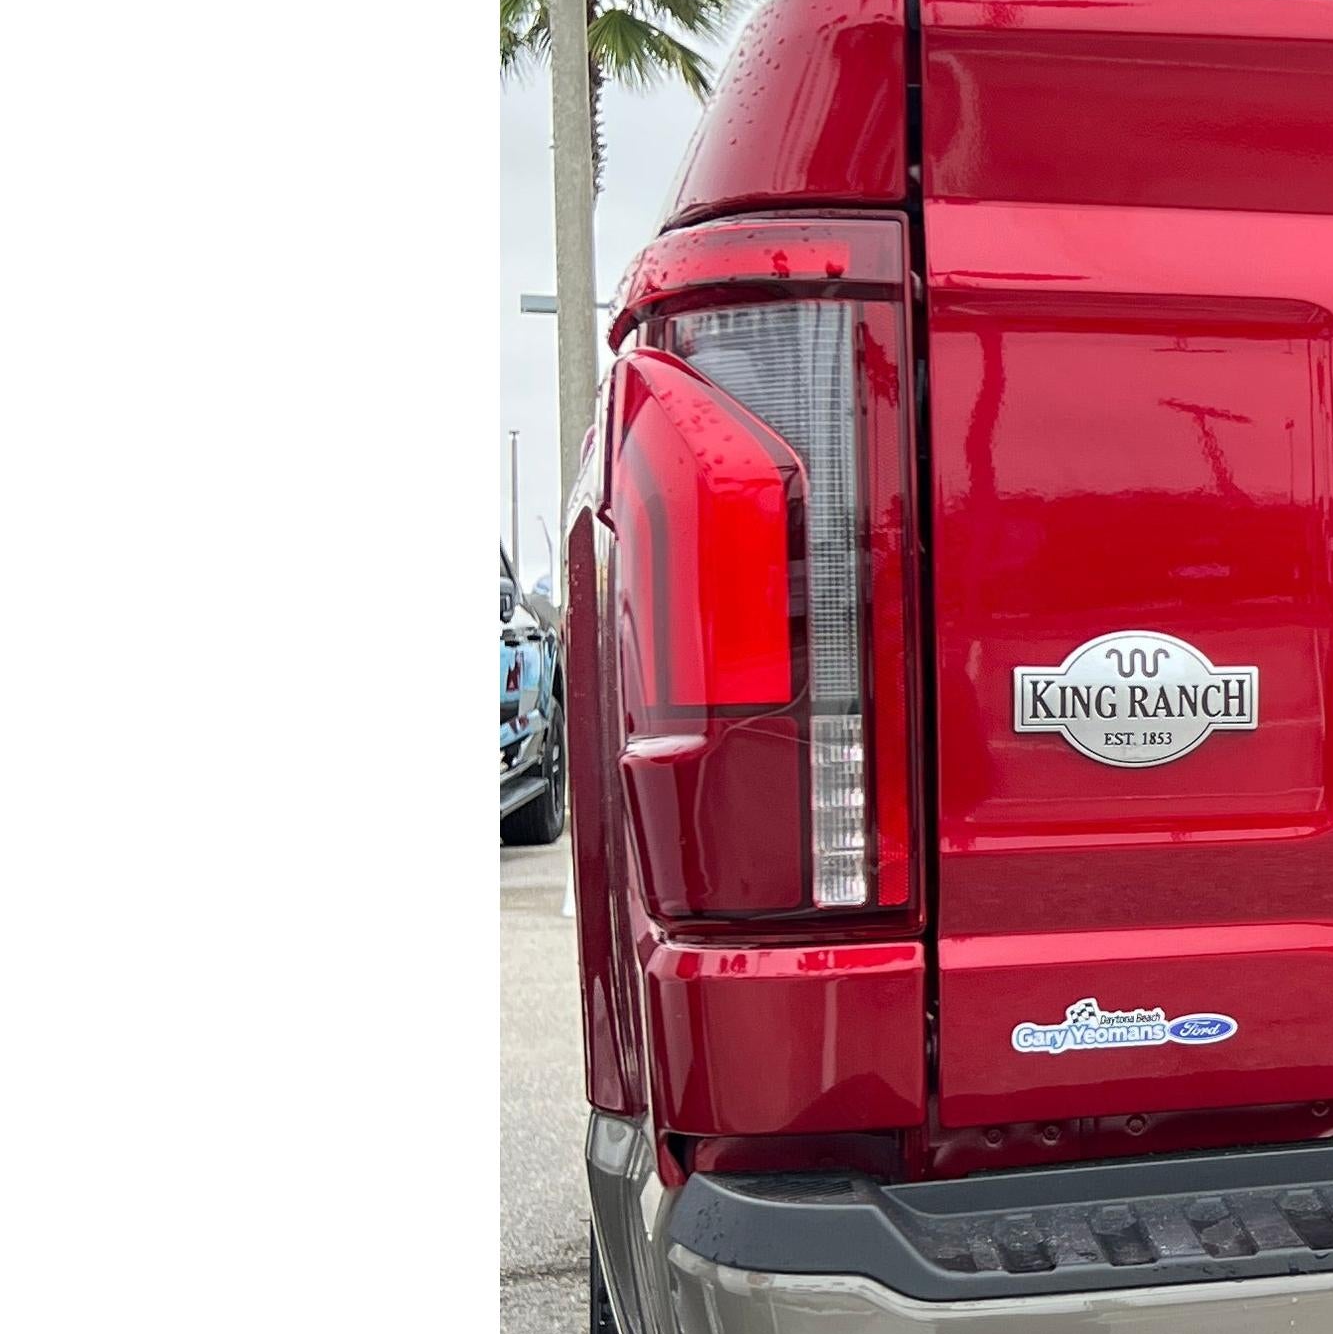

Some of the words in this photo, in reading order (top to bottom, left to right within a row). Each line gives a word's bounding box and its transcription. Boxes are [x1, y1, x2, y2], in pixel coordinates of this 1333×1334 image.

[1029, 680, 1116, 720] KING
[1127, 679, 1246, 719] RANCH
[1104, 732, 1137, 746] EST.
[1141, 731, 1173, 746] 1853
[1100, 1014, 1135, 1026] Daytona
[1136, 1012, 1161, 1024] Beach
[1016, 1027, 1068, 1050] Gary
[1068, 1023, 1166, 1046] Yeomans
[1180, 1020, 1220, 1037] Ford
